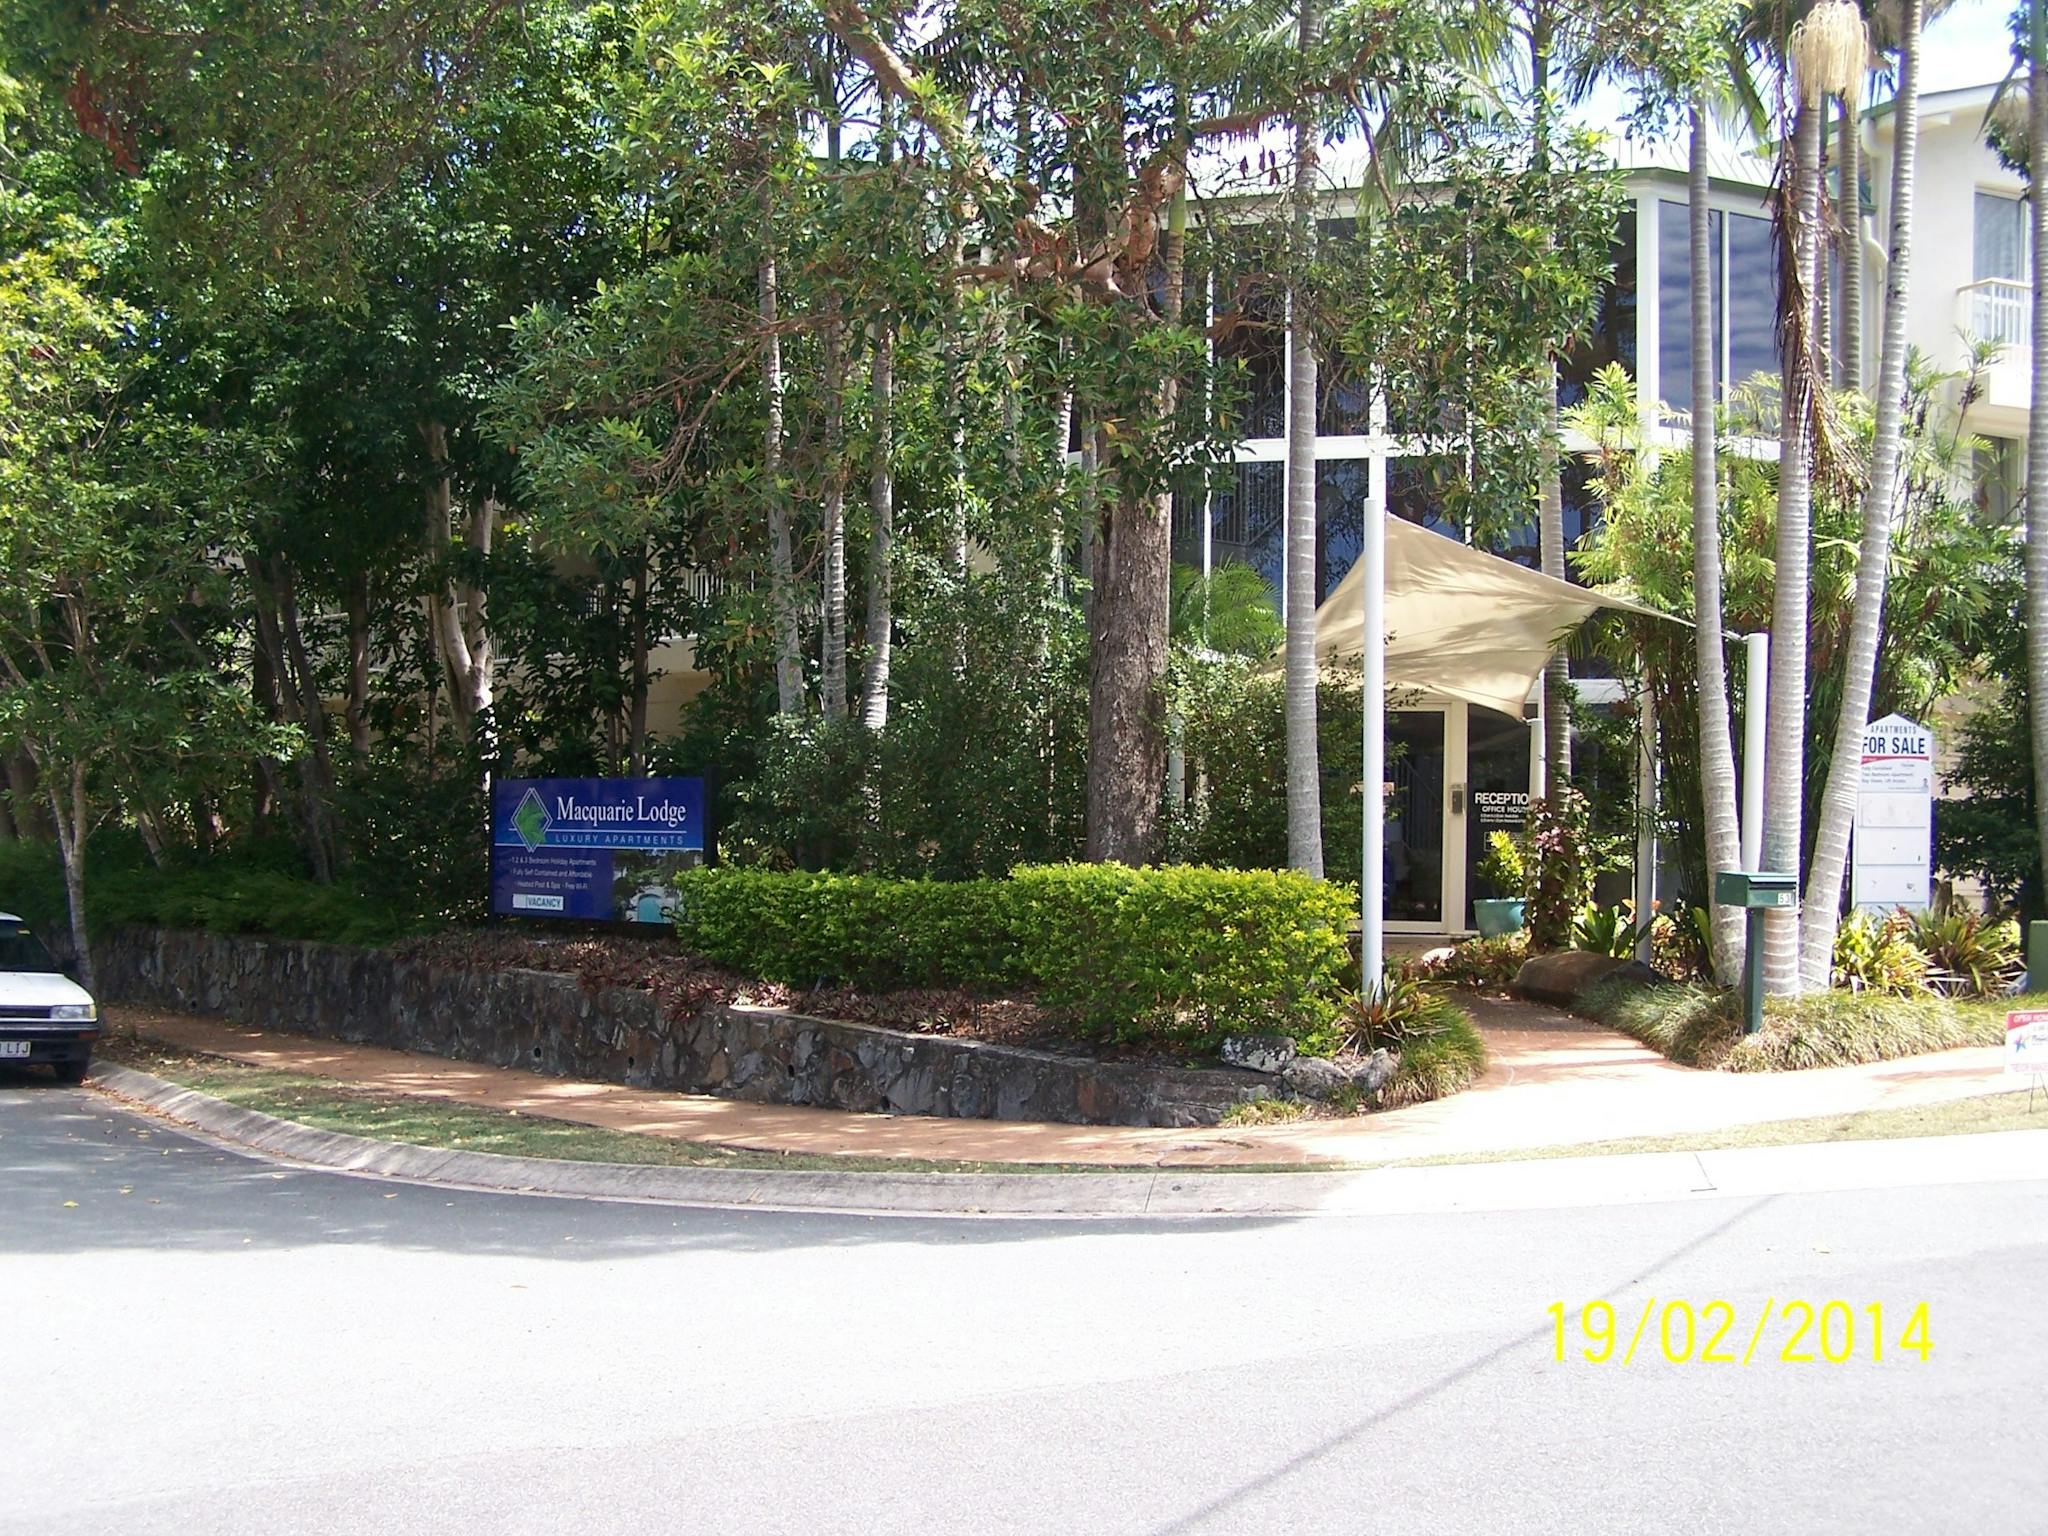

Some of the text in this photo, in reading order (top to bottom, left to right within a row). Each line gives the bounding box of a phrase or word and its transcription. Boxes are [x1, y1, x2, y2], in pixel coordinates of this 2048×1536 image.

[1871, 725, 1917, 735] APARTMENTS
[1862, 736, 1925, 754] FOR SALE
[1475, 792, 1529, 805] RECEPTIO
[557, 796, 687, 827] Macquarie Lodge
[555, 834, 684, 845] LUXURY APARTMENTS
[528, 897, 562, 908] VACANCY
